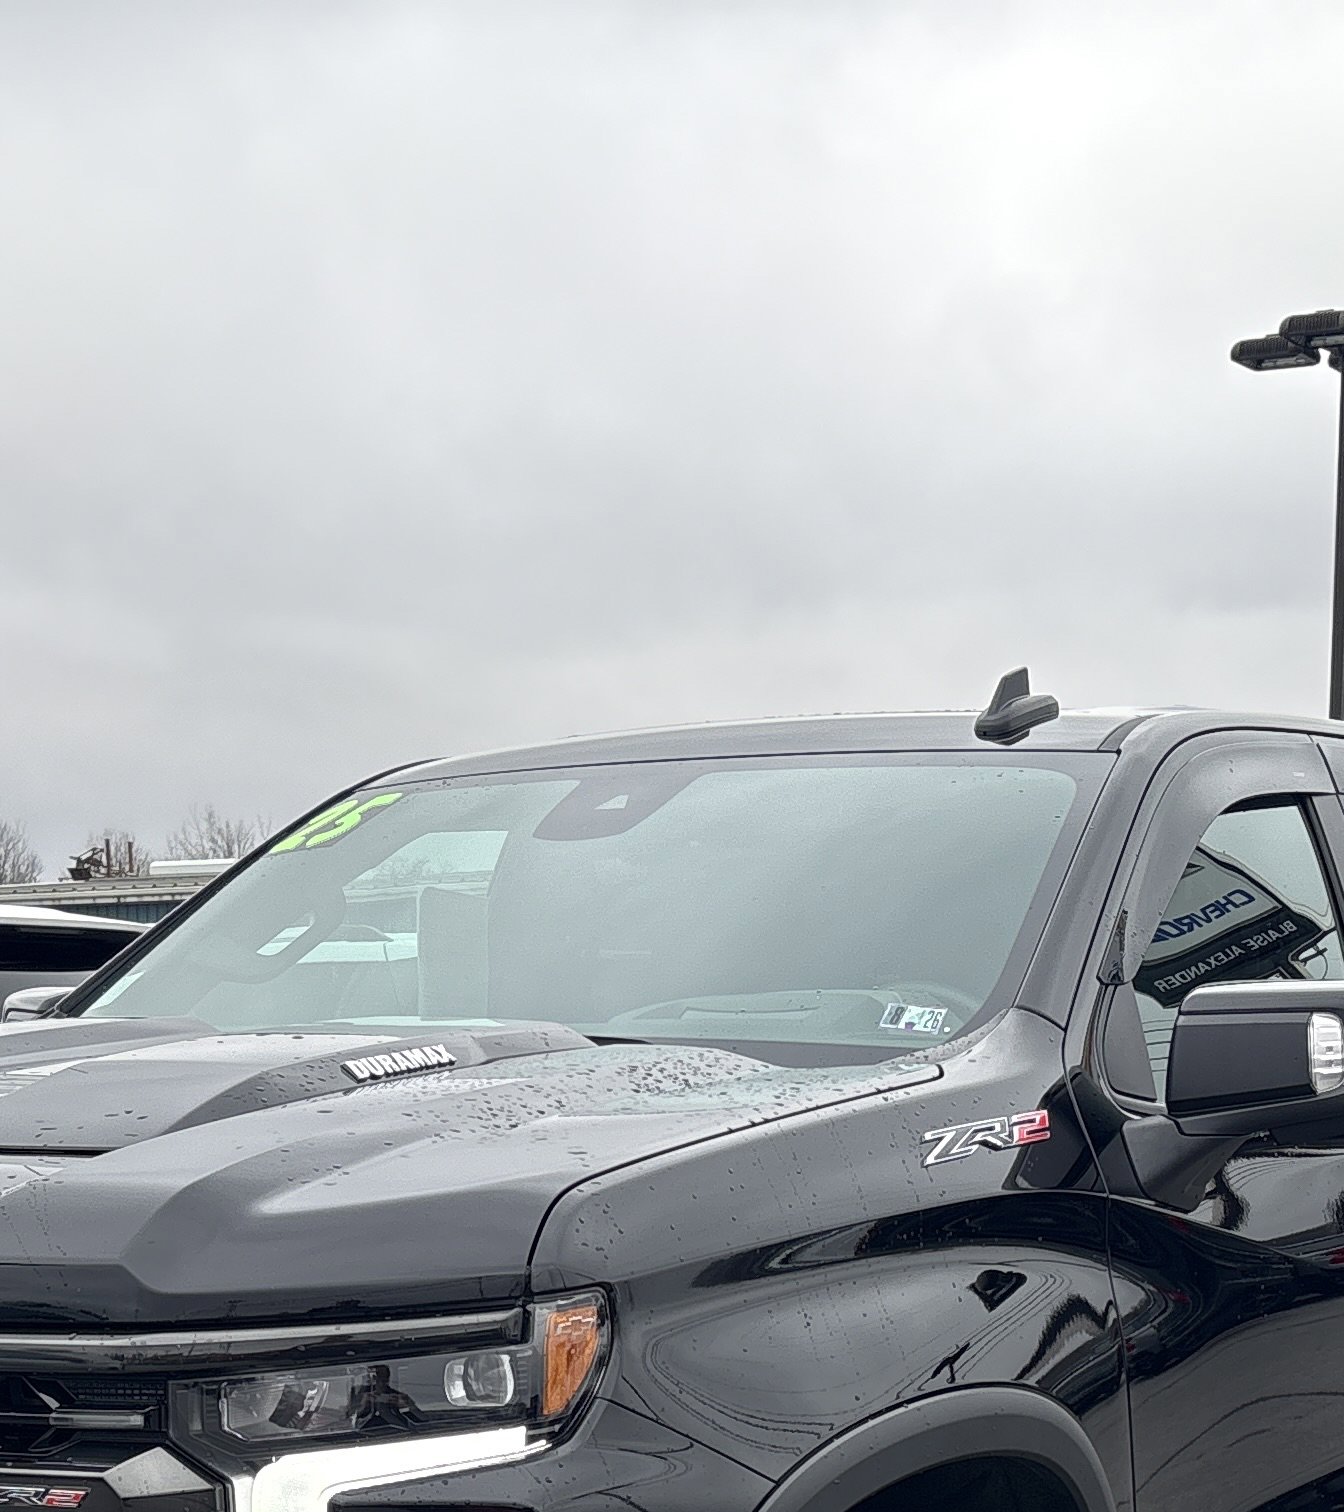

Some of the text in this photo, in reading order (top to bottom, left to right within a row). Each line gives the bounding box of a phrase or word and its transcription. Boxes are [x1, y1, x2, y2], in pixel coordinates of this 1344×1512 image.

[269, 792, 403, 855] 25
[923, 1010, 943, 1030] 26
[342, 1044, 457, 1081] DURAMAX
[921, 1109, 1051, 1167] ZR2
